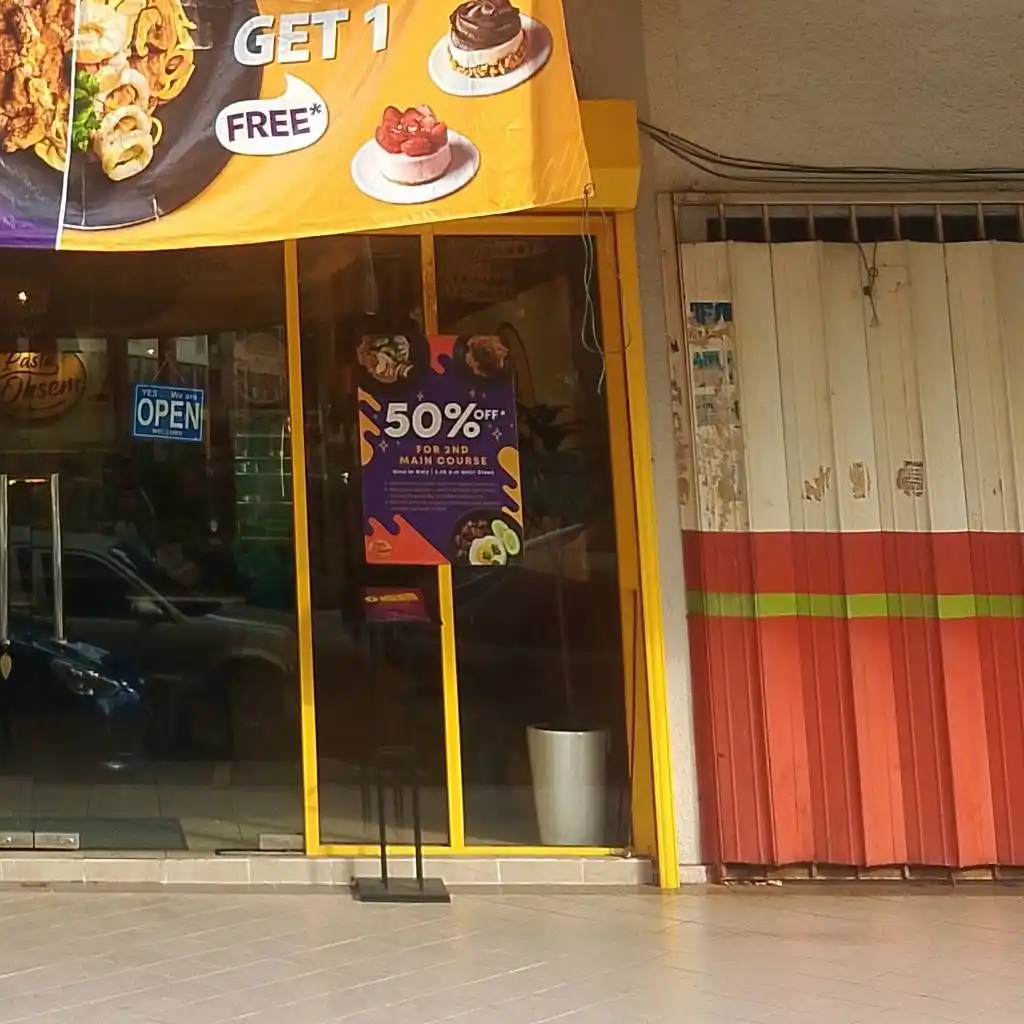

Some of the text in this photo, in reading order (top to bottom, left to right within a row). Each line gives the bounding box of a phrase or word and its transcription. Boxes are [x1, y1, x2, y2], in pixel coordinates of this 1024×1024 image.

[234, 3, 389, 66] GET 1
[137, 397, 200, 430] OPEN
[384, 402, 481, 439] 50%
[399, 456, 488, 465] MAIN COURSE
[416, 445, 469, 454] FOR 2ND
